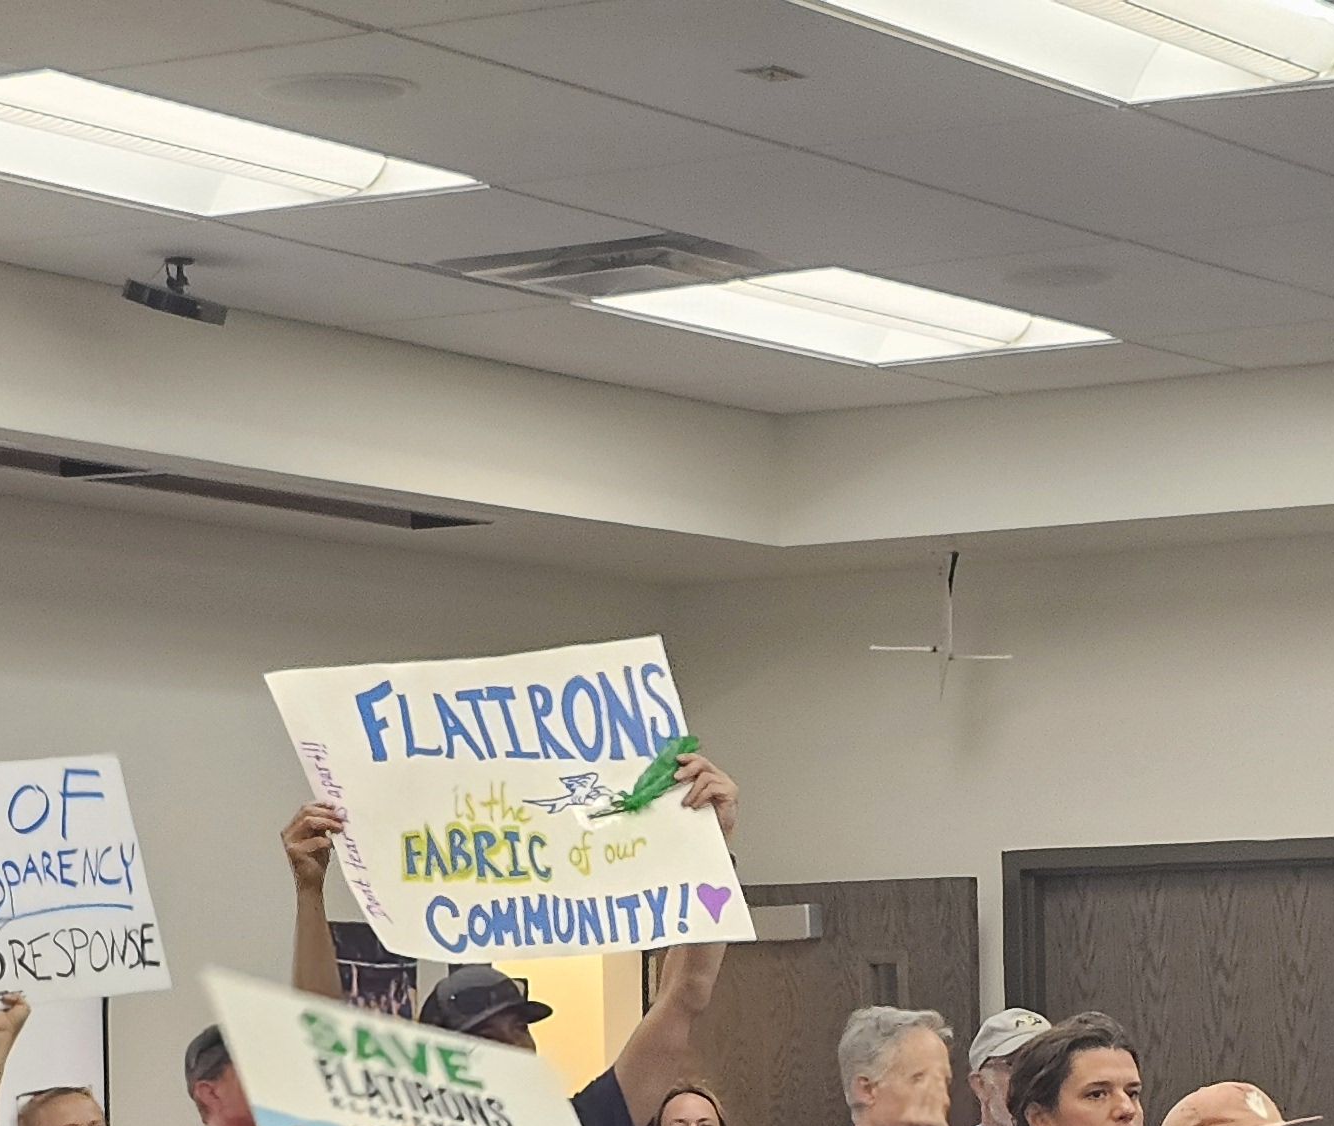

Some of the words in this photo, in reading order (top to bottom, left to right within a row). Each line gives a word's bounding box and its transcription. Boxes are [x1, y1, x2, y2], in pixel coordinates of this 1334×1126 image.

[355, 662, 681, 763] FLATIRONS
[7, 767, 105, 841] OF
[453, 790, 475, 822] is
[479, 781, 532, 824] the
[404, 825, 552, 883] FABRIC
[569, 830, 597, 875] of
[604, 836, 649, 869] our
[8, 922, 161, 982] RESPONSE
[425, 882, 691, 954] COMMUNITY!
[297, 1006, 486, 1091] SAVE
